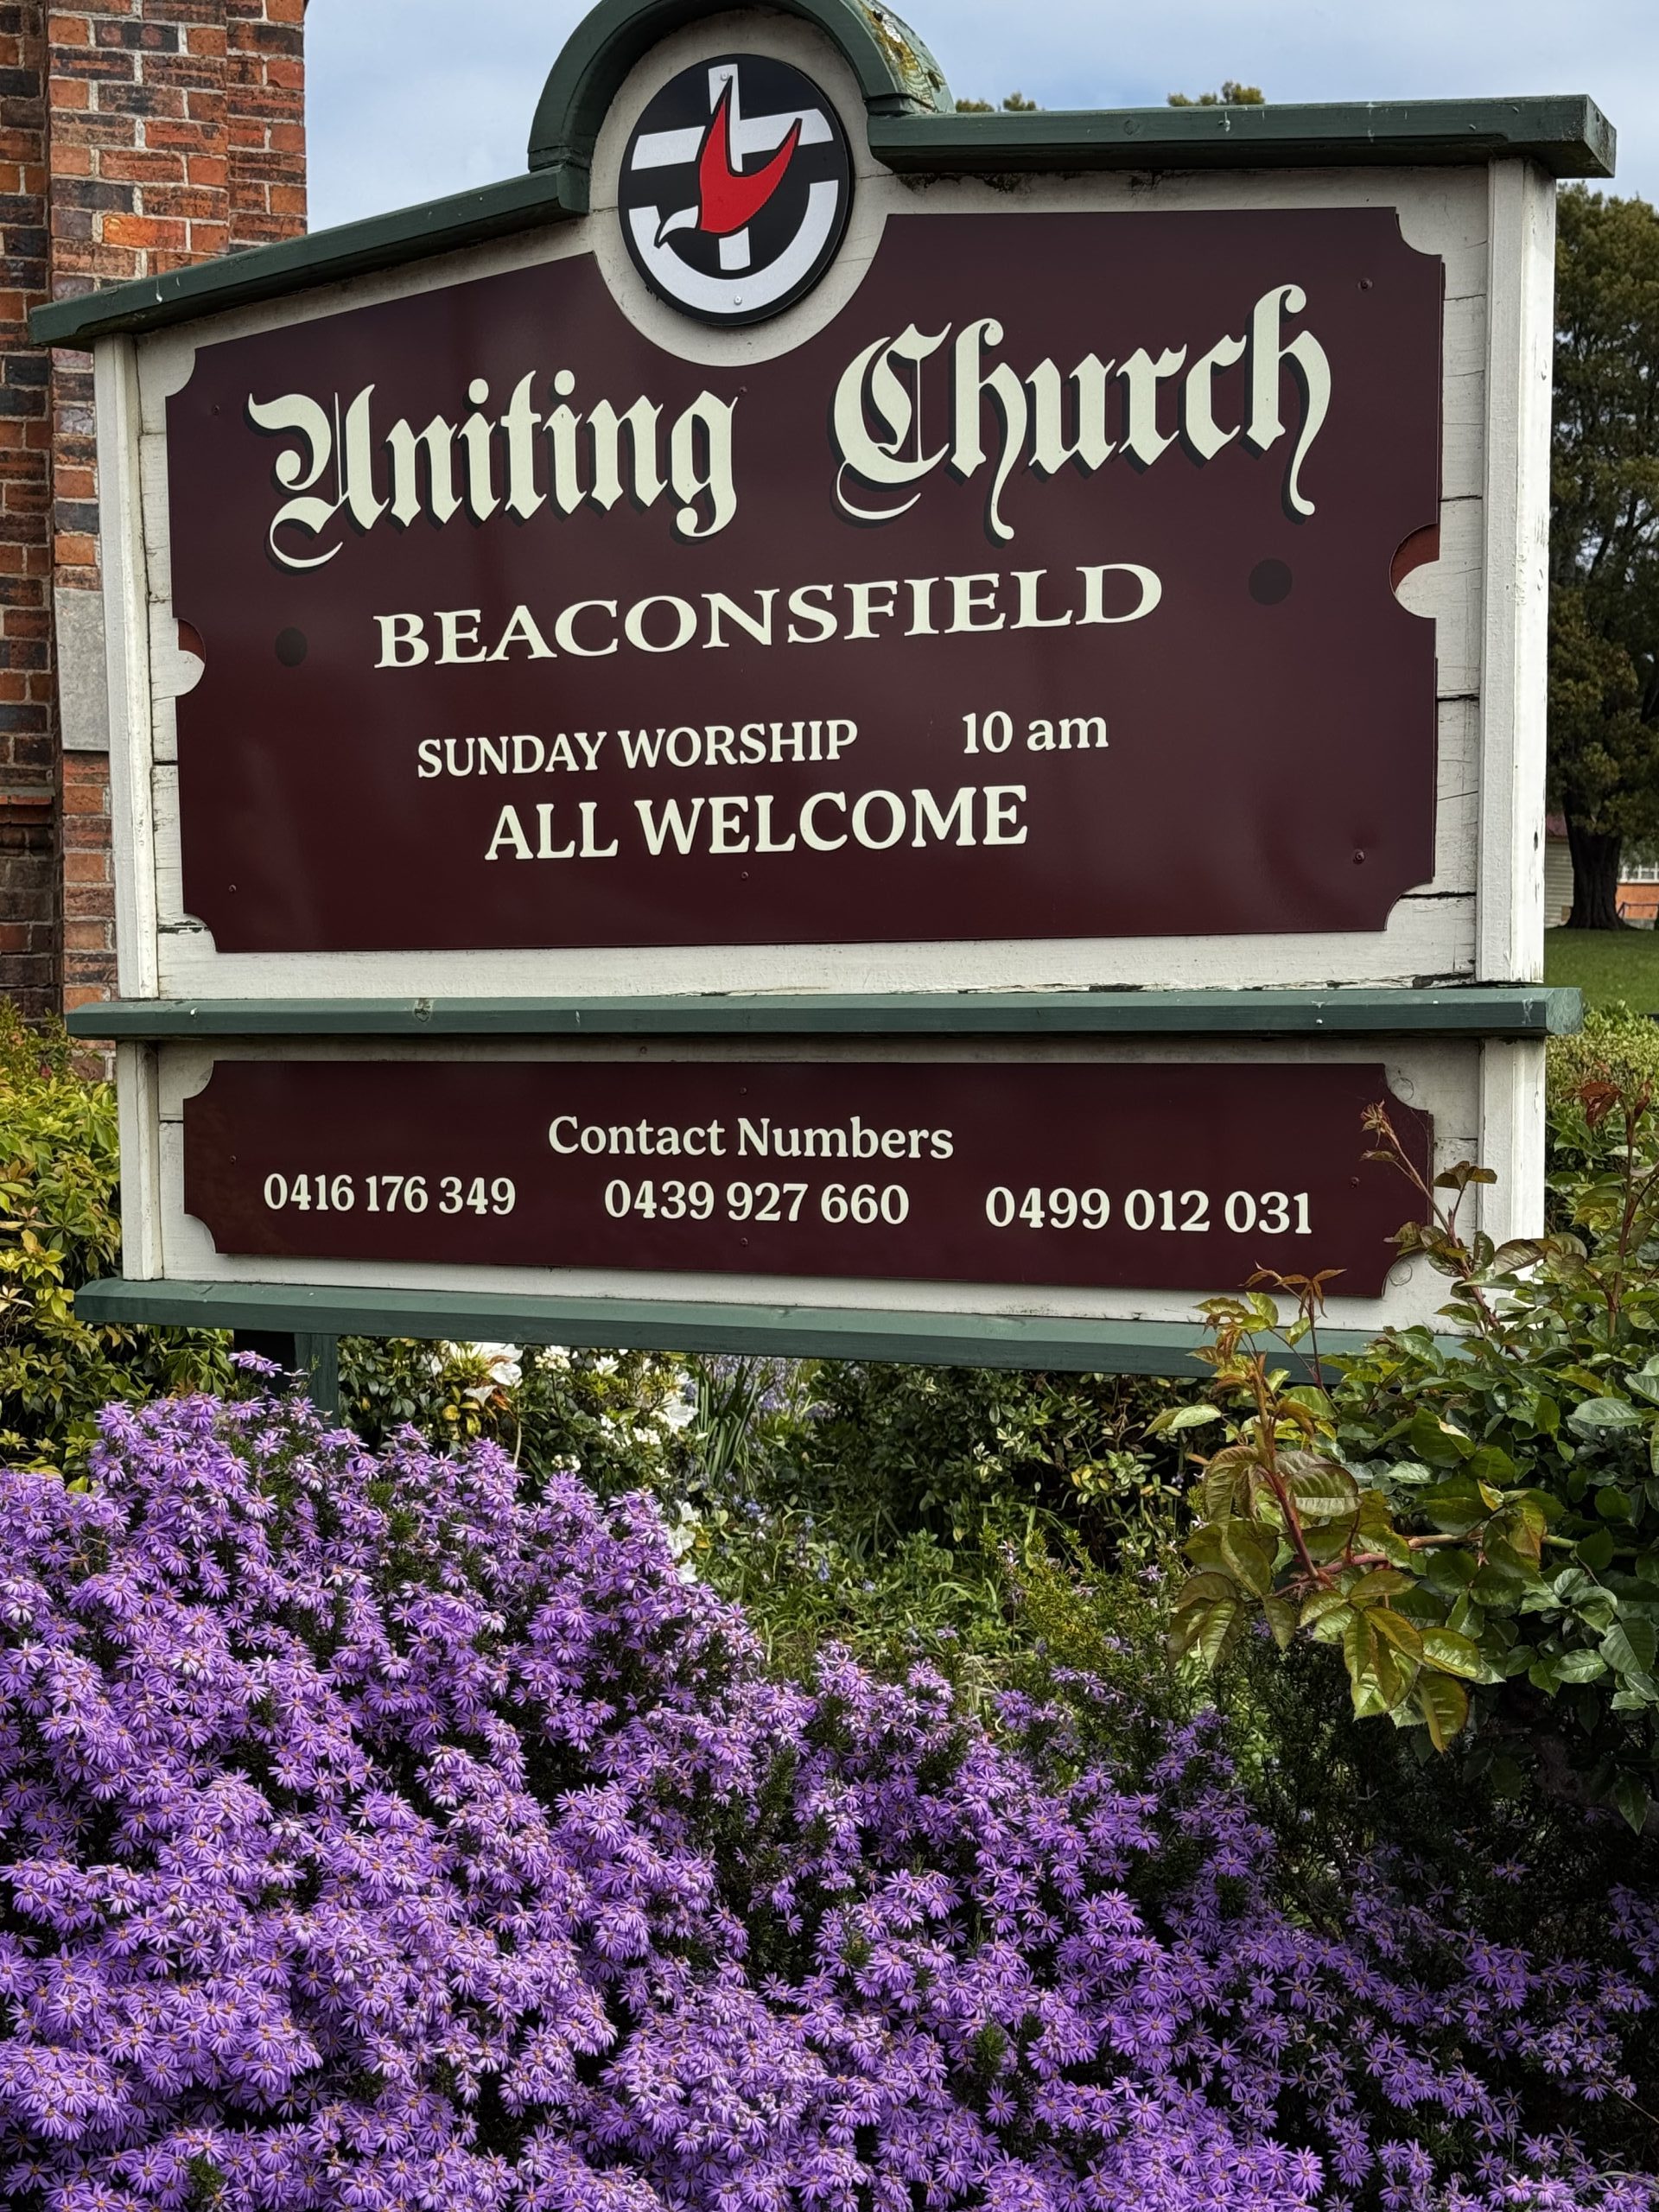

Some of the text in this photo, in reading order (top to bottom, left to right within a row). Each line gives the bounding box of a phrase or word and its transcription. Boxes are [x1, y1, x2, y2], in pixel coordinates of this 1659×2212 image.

[248, 283, 1332, 569] Uniting Church
[372, 563, 1162, 669] BEACONSFIELD
[417, 710, 1110, 779] SUNDAY WORSHIP 10 am
[484, 785, 1029, 861] ALL WELCOME
[549, 1116, 955, 1160] Contact Numbers
[264, 1173, 1313, 1236] 0416 176 349 0439 927 660 0499 012 031
